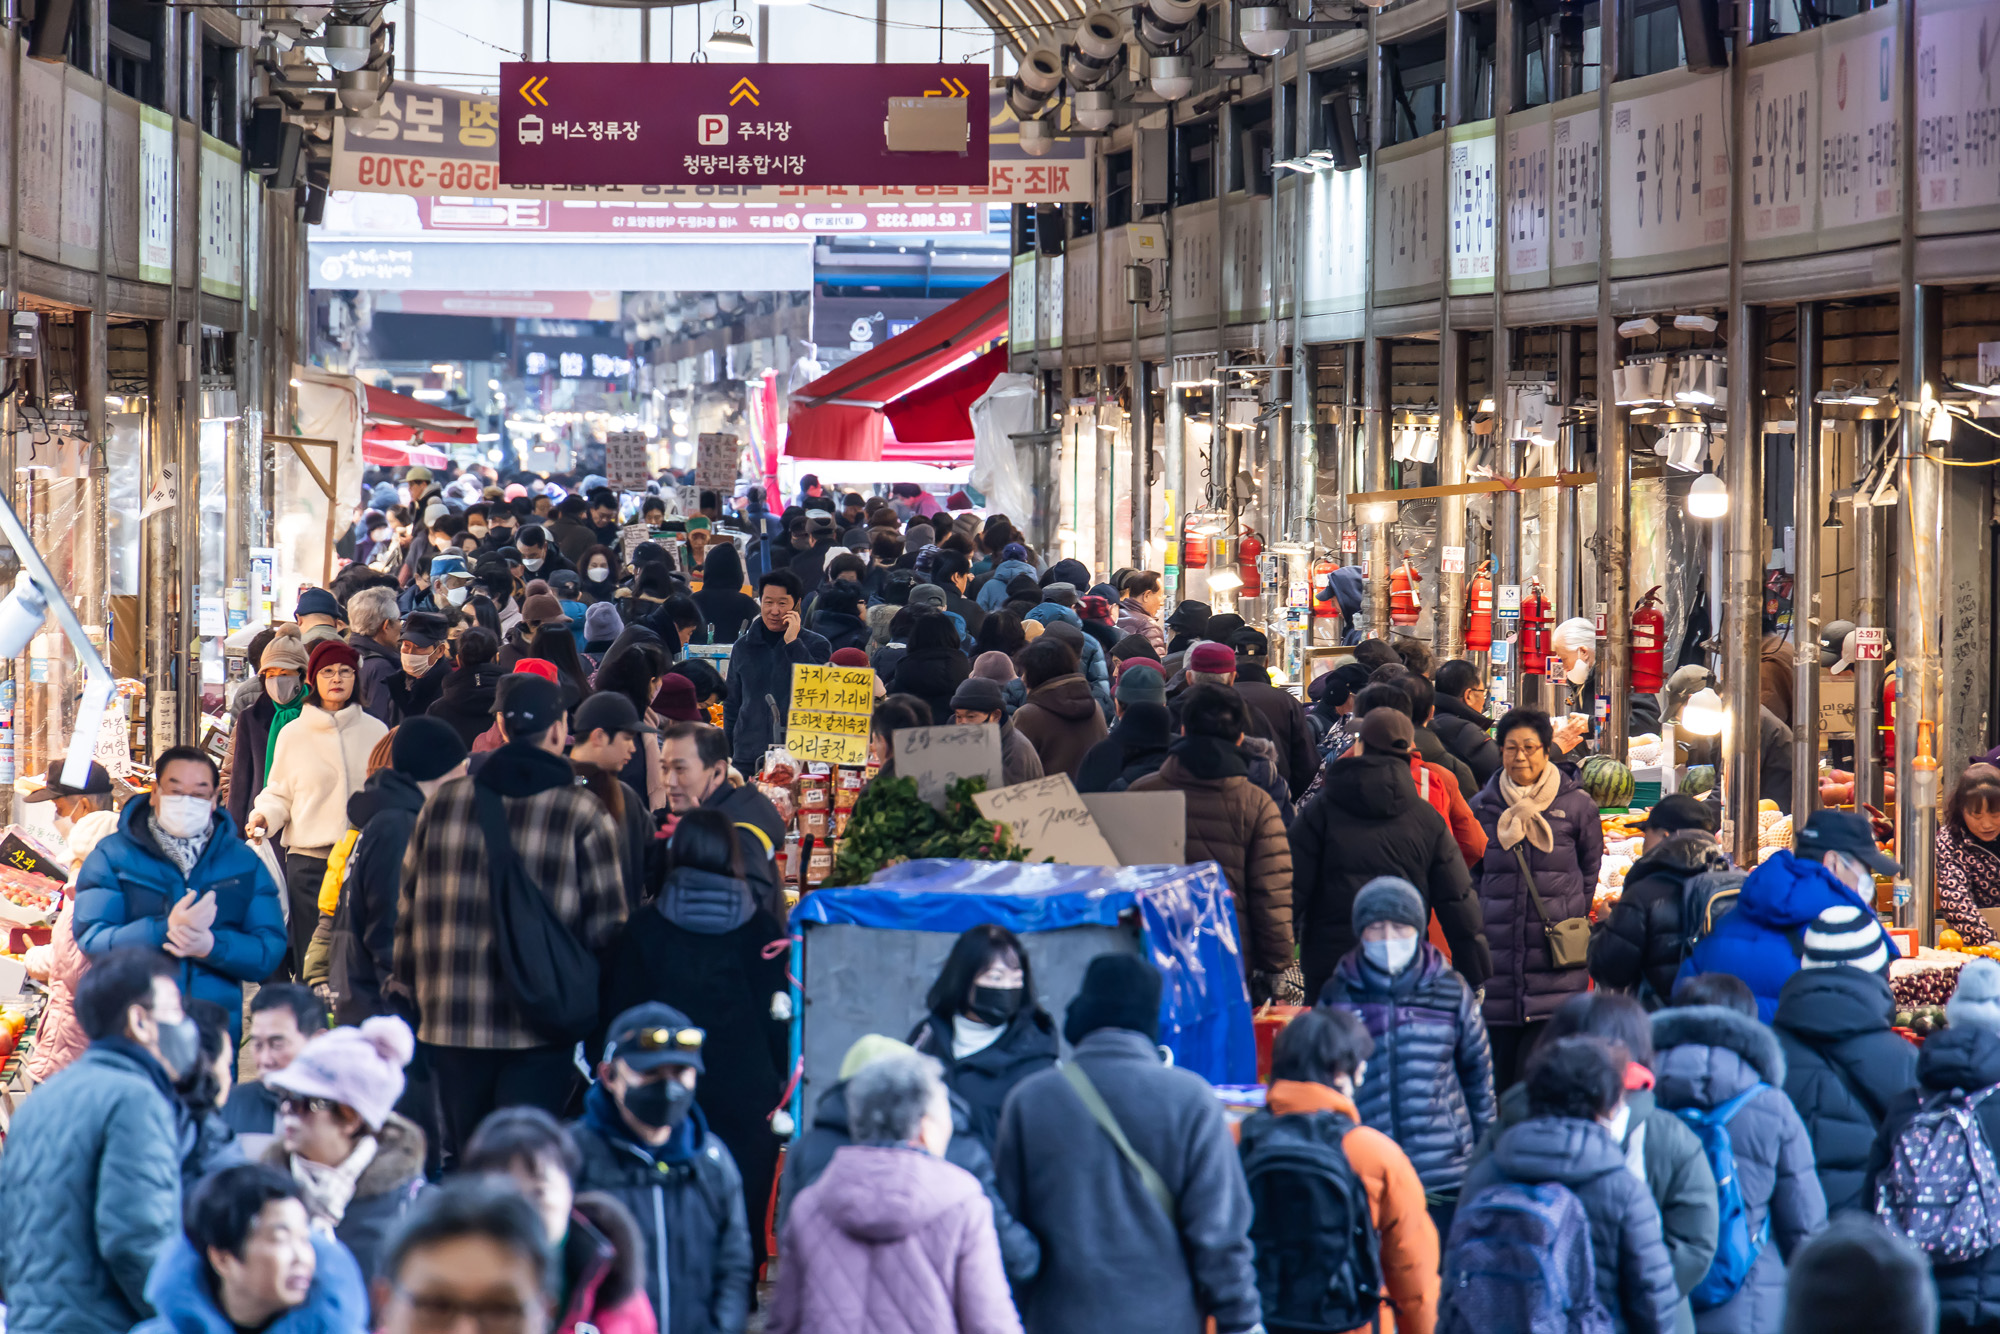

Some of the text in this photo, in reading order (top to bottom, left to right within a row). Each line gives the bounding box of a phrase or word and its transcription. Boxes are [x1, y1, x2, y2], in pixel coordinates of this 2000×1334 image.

[551, 121, 641, 141] 버스정류장
[737, 121, 792, 141] 주차장
[683, 154, 807, 175] 청량리종합시장
[1636, 113, 1702, 228] 중앙상회
[1858, 630, 1881, 639] 소화기
[788, 735, 846, 761] 어리굴젓
[12, 849, 37, 871] 사과
